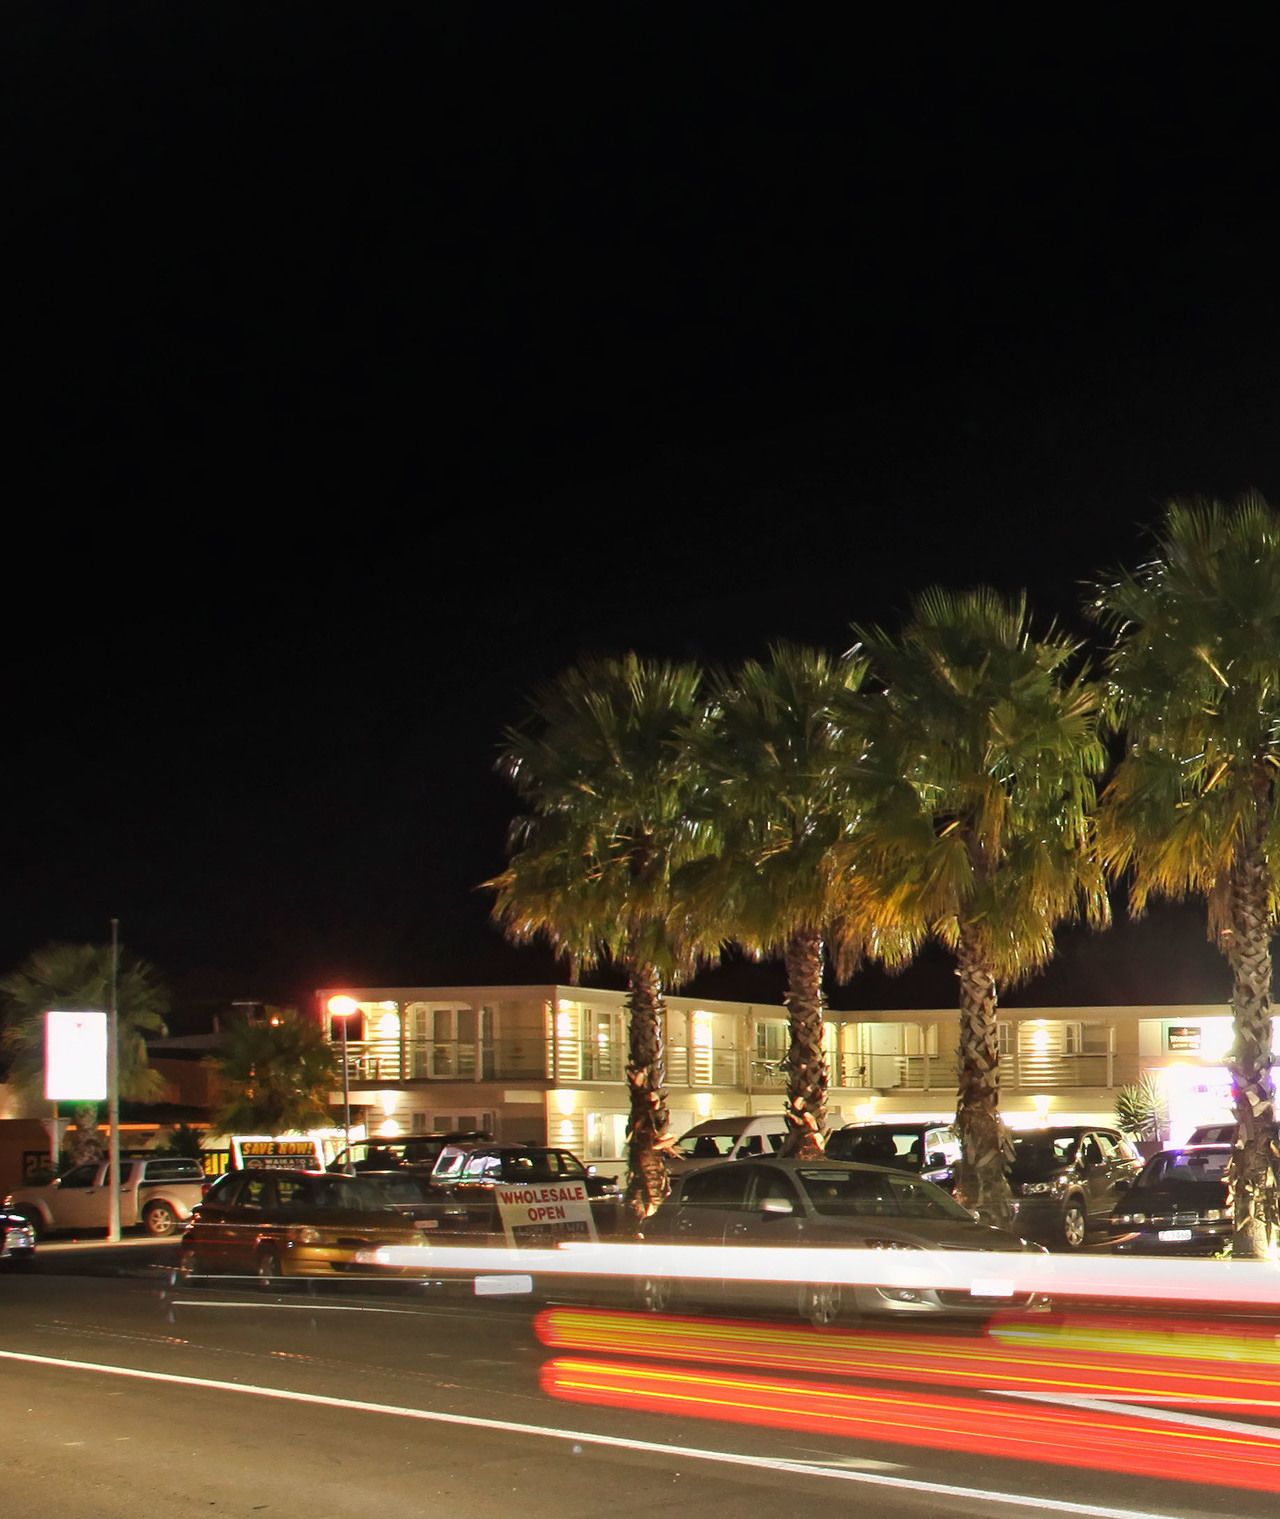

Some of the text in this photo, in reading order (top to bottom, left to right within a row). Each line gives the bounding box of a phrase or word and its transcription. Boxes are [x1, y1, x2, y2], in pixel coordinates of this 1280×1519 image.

[243, 1142, 274, 1155] SAVE
[501, 1187, 584, 1204] WHOLESALE
[528, 1206, 566, 1221] OPEN
